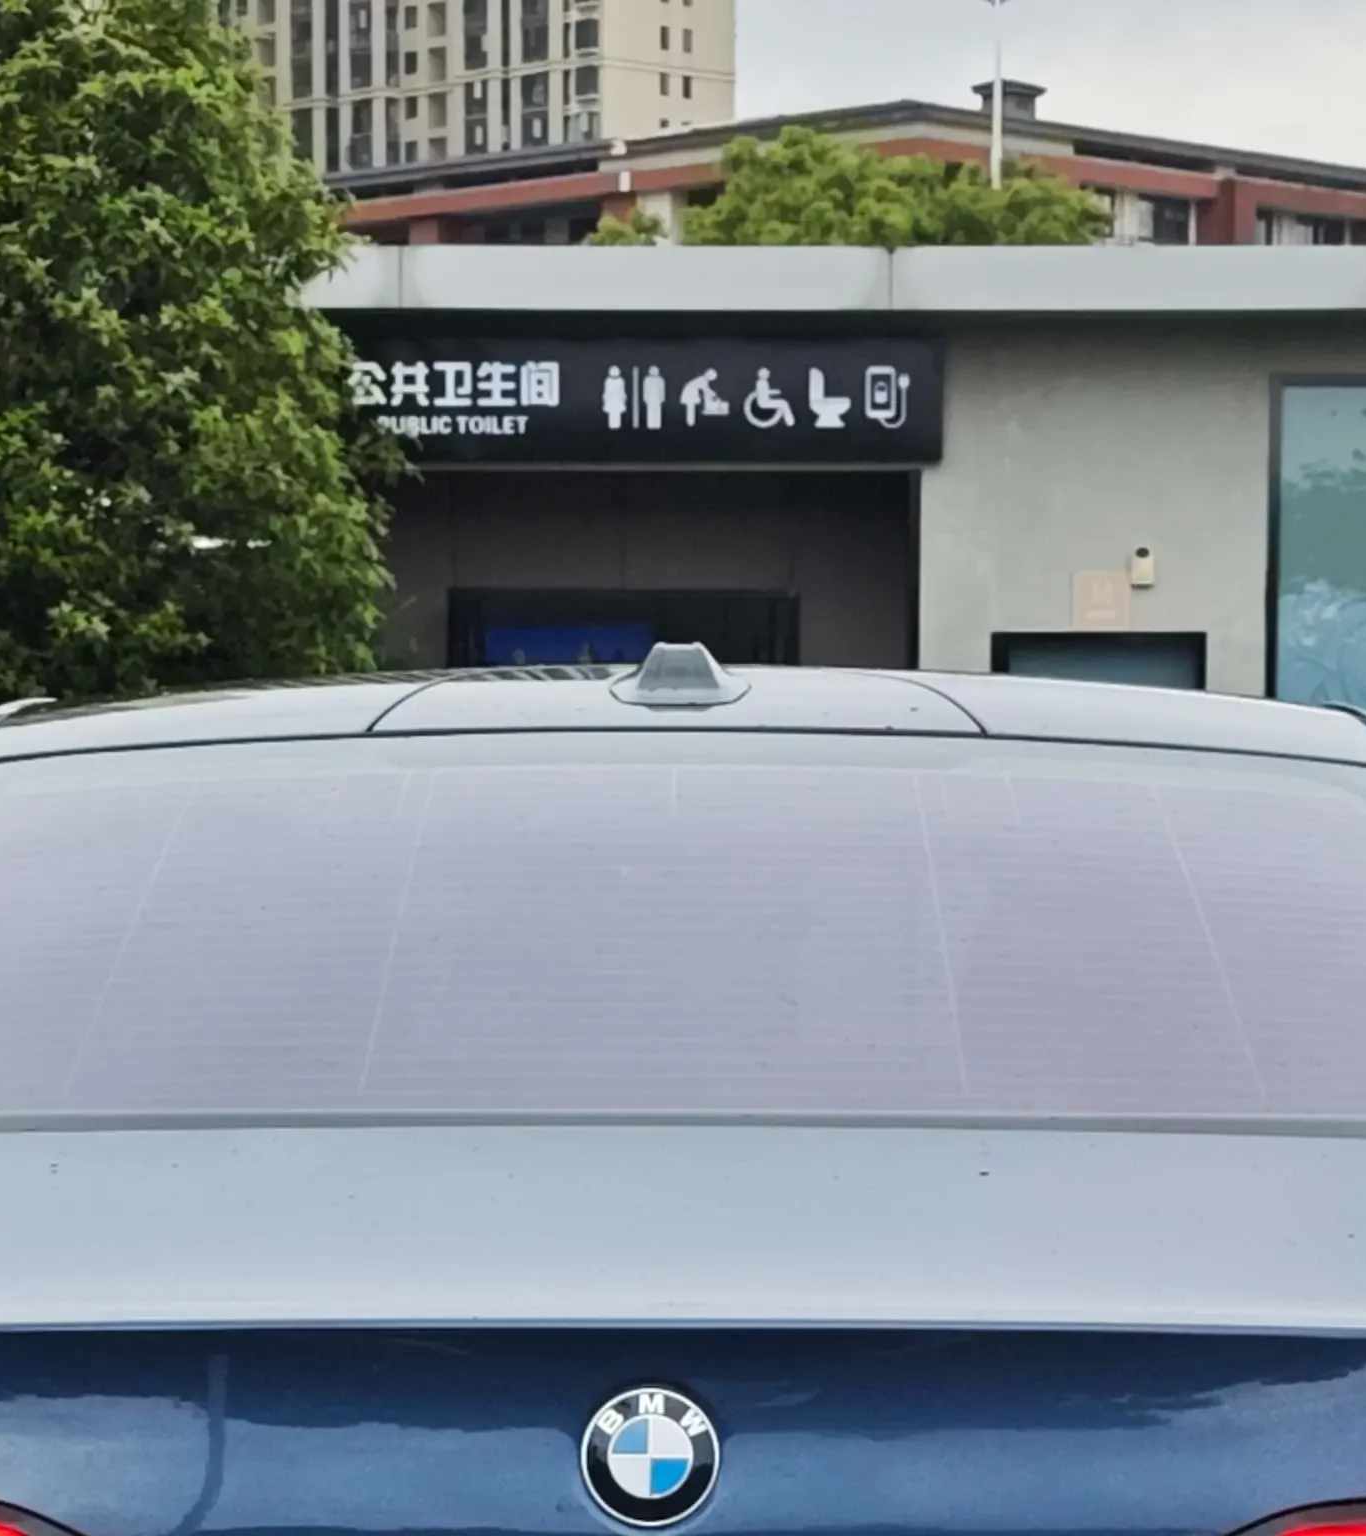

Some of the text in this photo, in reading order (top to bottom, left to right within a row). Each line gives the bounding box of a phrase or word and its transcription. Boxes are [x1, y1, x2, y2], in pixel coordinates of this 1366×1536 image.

[347, 361, 560, 407] 公共卫生间
[456, 415, 529, 434] TOILET
[597, 1393, 707, 1437] BMW
